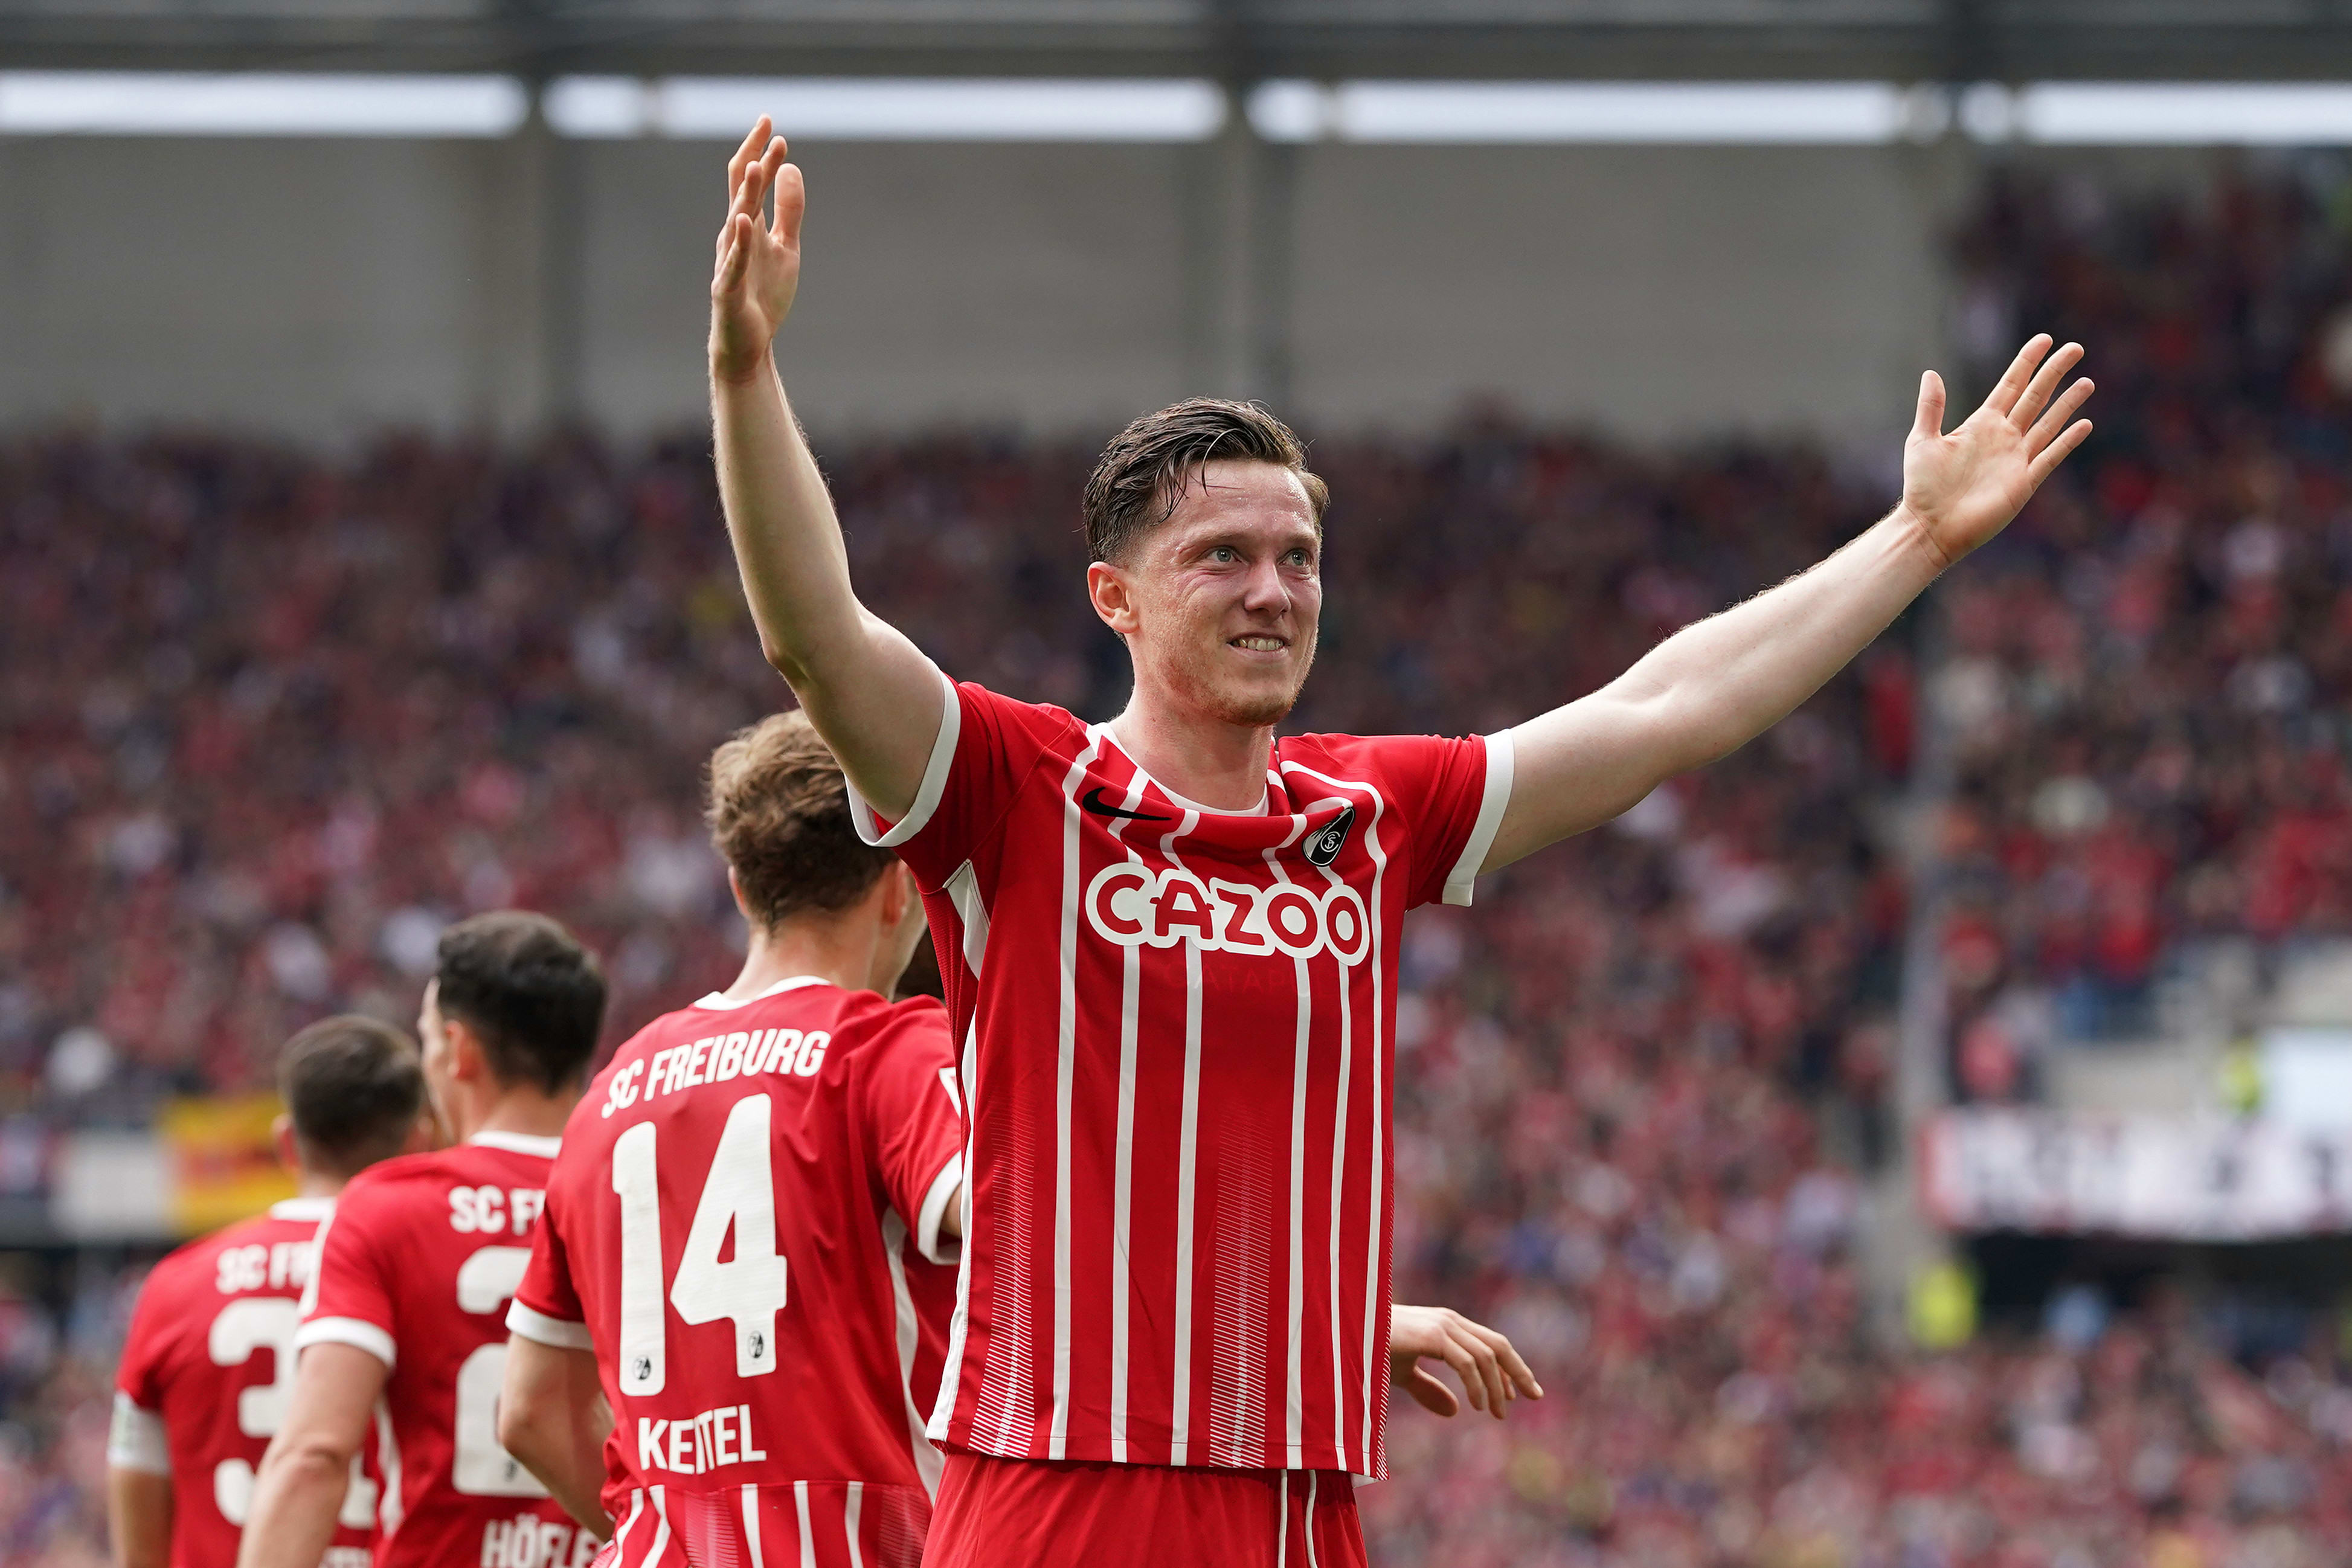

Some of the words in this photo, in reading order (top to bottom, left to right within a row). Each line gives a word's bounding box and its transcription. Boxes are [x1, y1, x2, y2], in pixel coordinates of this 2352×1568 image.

[1086, 862, 1370, 966] CAZOO
[602, 1058, 644, 1119] SC
[643, 1028, 832, 1102] FREIBURG
[448, 1184, 506, 1234] SC
[612, 1093, 788, 1396] 14
[215, 1244, 268, 1295] SC
